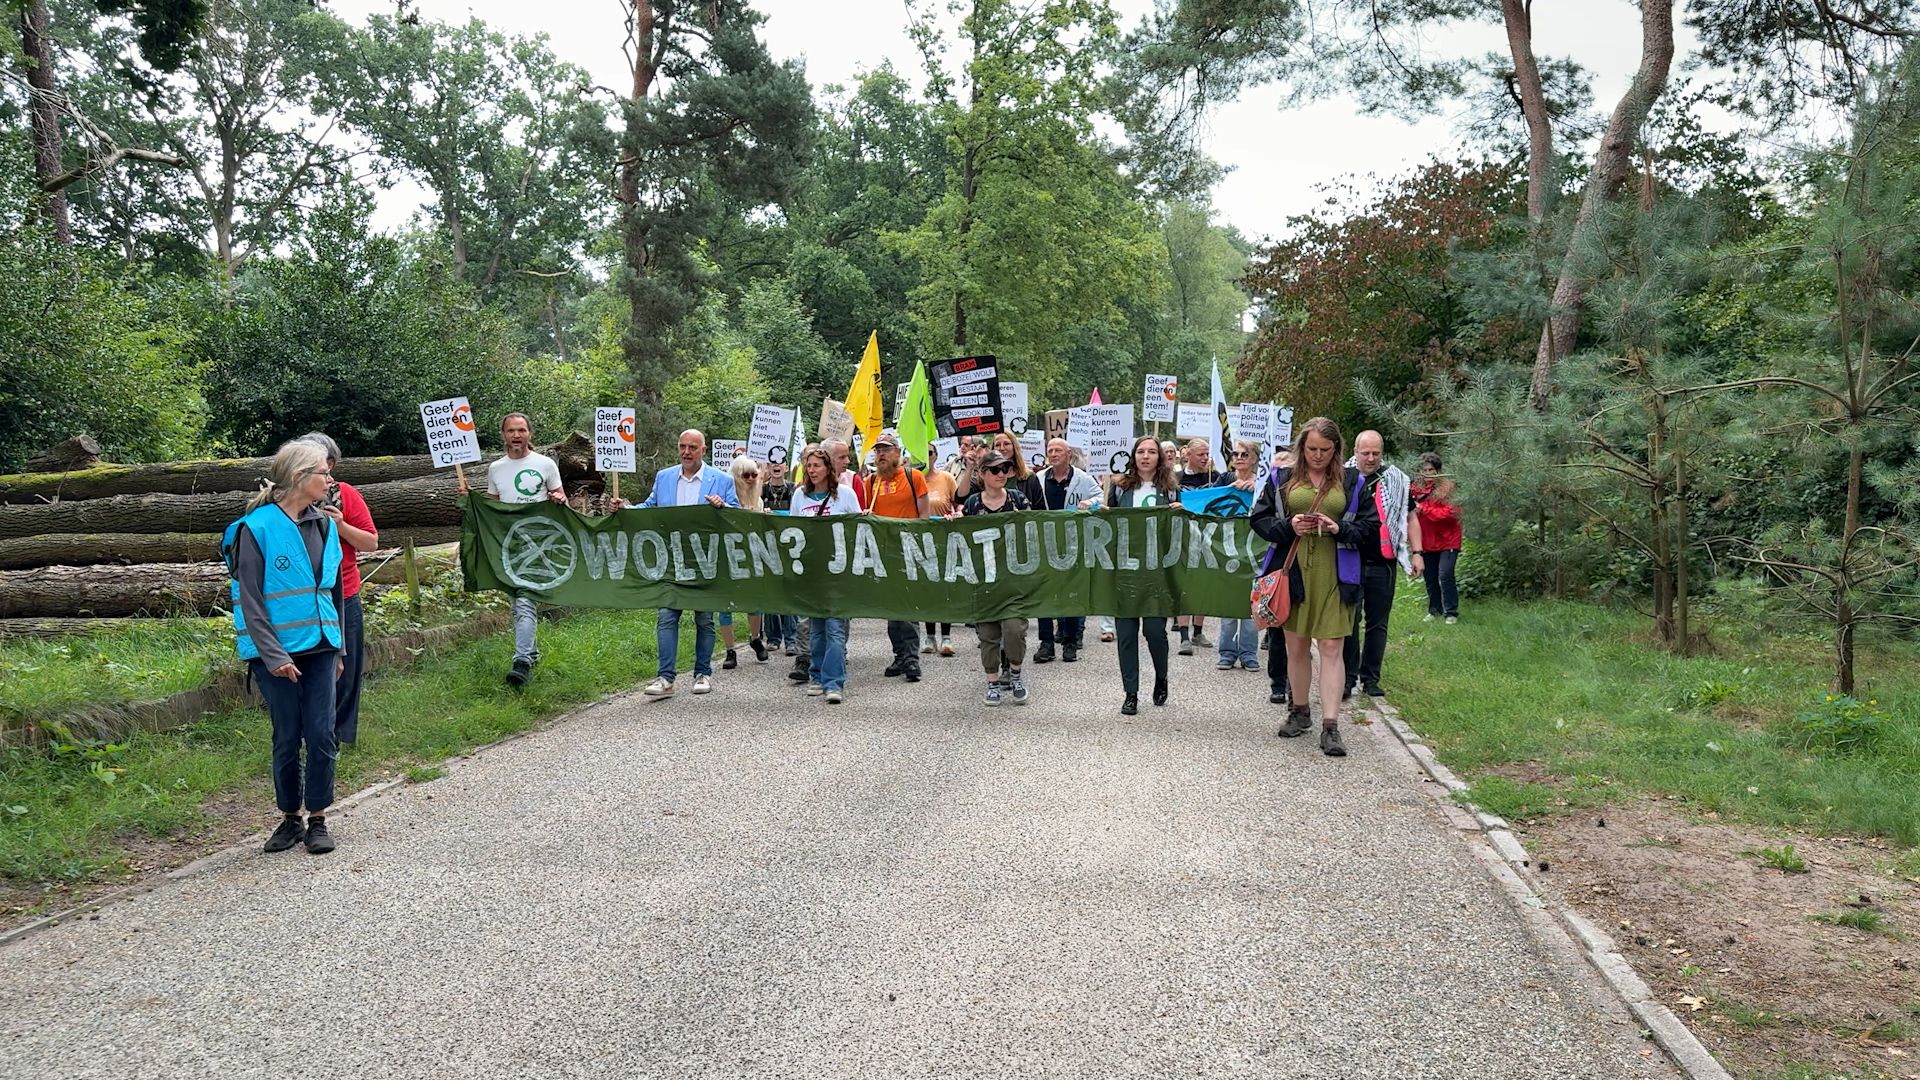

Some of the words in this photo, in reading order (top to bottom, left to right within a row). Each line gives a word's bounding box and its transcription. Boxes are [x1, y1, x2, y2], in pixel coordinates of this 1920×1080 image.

[956, 361, 974, 371] BRAM
[942, 378, 951, 386] DE
[974, 369, 993, 378] WOLF
[1148, 376, 1168, 384] Geef
[958, 384, 985, 393] BESTAAT
[1147, 385, 1173, 393] dieren
[424, 401, 454, 416] Geef
[757, 406, 780, 416] Dieren
[1145, 402, 1168, 410] stem!
[1243, 405, 1256, 413] Tijd
[426, 412, 467, 428] dieren
[598, 410, 621, 420] Geef
[755, 415, 781, 425] kunnen
[597, 422, 630, 432] dieren
[1241, 422, 1265, 430] klimaa
[430, 429, 453, 440] een
[752, 431, 777, 441] kiezen,
[778, 434, 786, 443] jij
[432, 436, 468, 451] stem!
[597, 436, 616, 444] een
[1091, 438, 1118, 446] kiezen,
[714, 441, 736, 450] Geef
[597, 446, 627, 456] stem!
[578, 527, 806, 581] WOLVEN?
[828, 522, 887, 578] JA
[901, 517, 1240, 584] NATUURLIJK!
